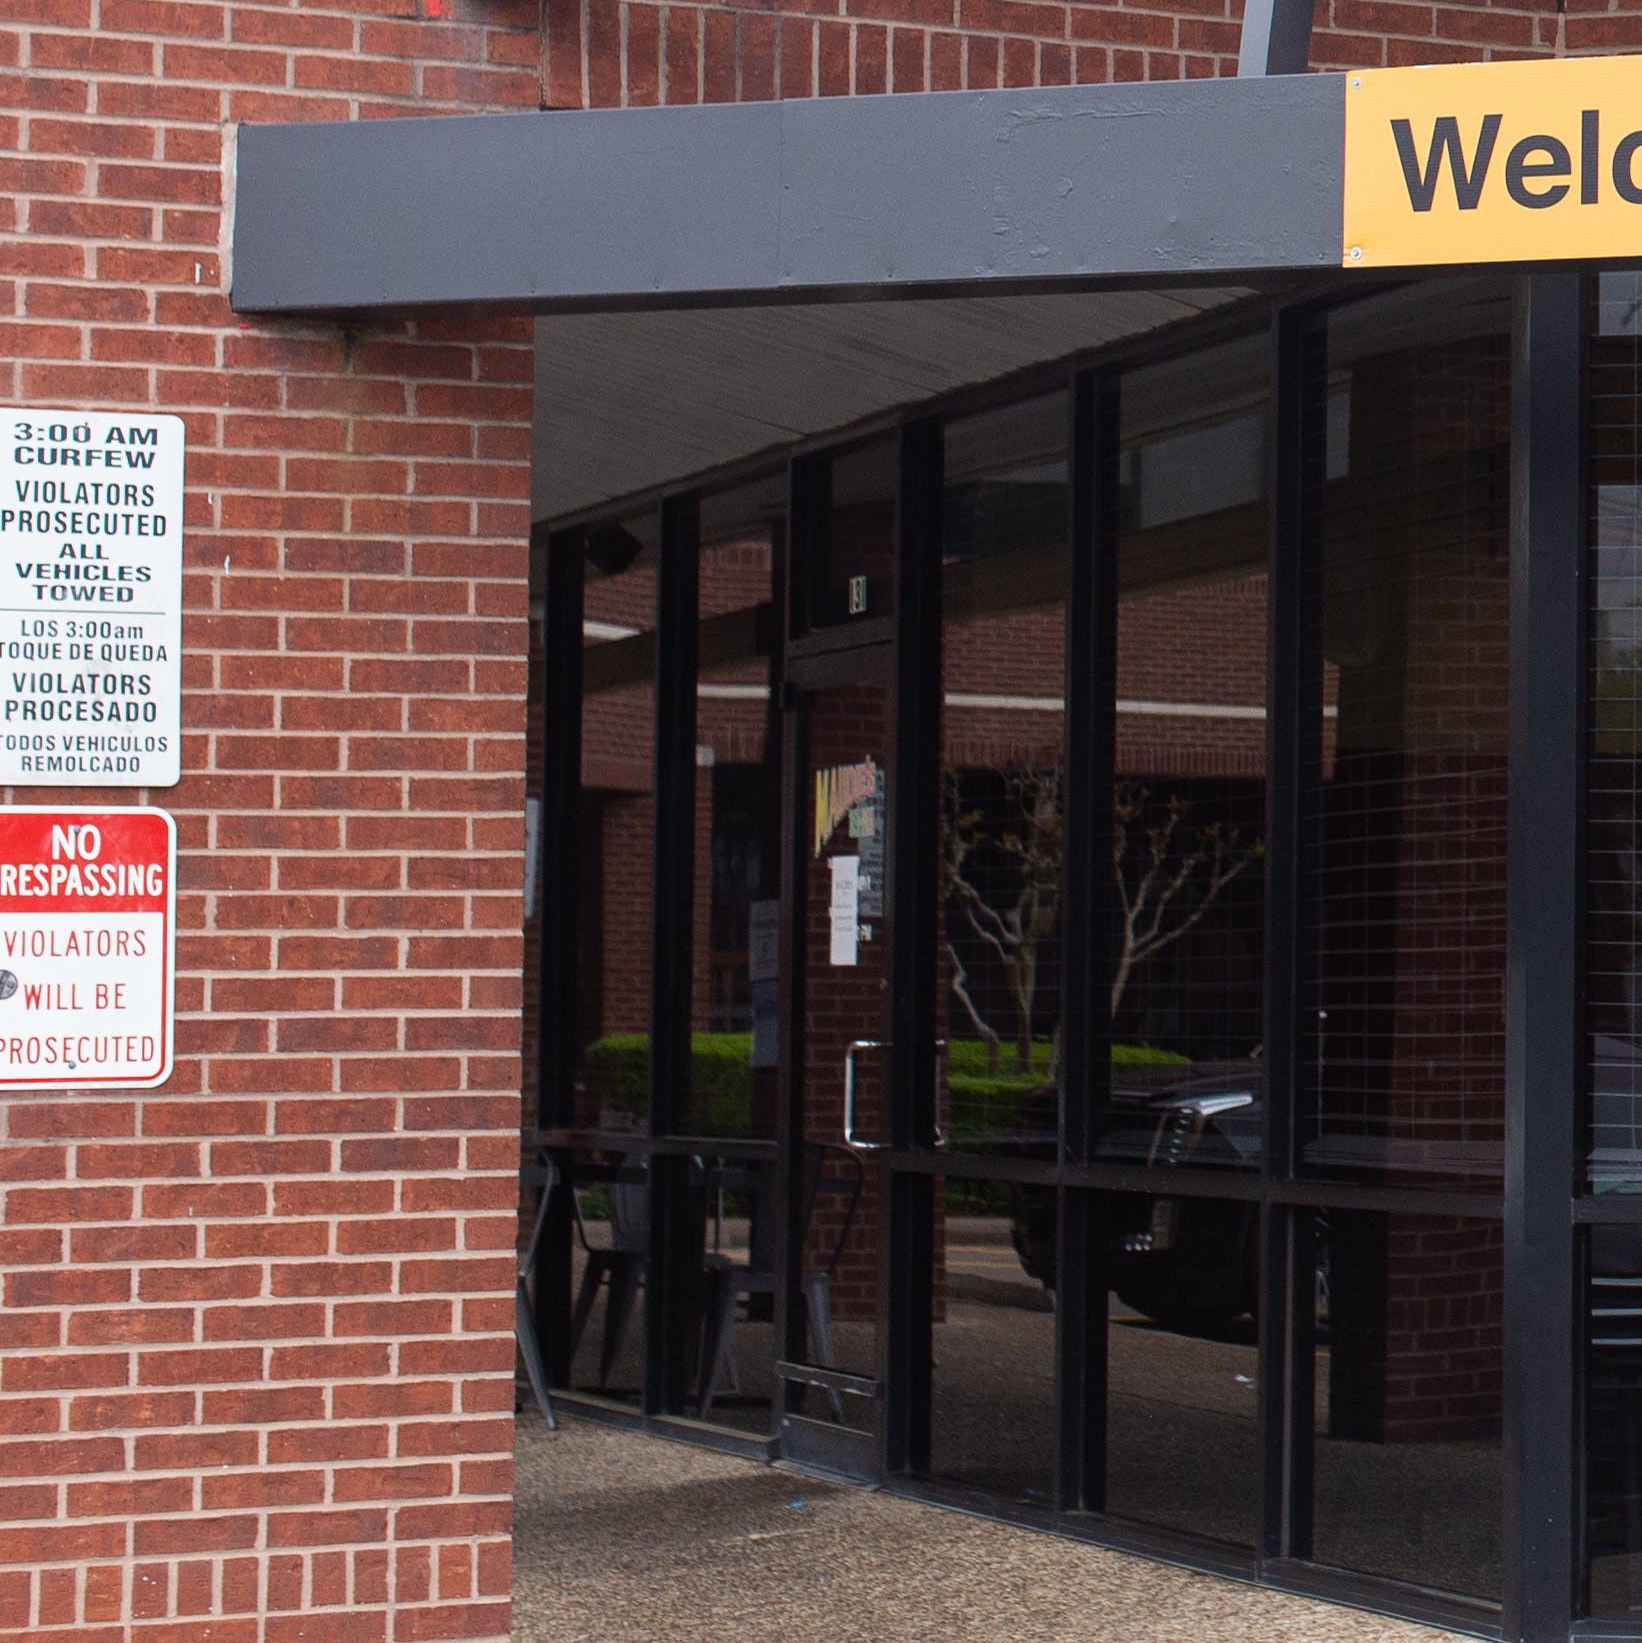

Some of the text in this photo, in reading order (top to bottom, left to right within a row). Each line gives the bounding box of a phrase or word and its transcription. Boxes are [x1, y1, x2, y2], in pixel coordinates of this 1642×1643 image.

[14, 423, 158, 446] 3:00 AM
[14, 446, 155, 469] CURFEW
[16, 480, 154, 507] VIOLATORS
[1, 510, 167, 536] PROSECUTED
[59, 543, 109, 560] ALL
[16, 563, 151, 582] VEHICLES
[33, 584, 134, 603] TOWED
[21, 619, 143, 640] LOS 3:00am
[70, 642, 94, 660] DE
[100, 643, 168, 662] QUEDA
[12, 672, 151, 695] VIOLATORS
[5, 700, 157, 722] PROCESADO
[0, 734, 168, 752] ODOS VEHICULOS
[21, 756, 140, 773] REMOLCADO
[52, 824, 101, 860] NO
[5, 929, 146, 957] VIOLATORS
[24, 983, 126, 1010] WILL BE
